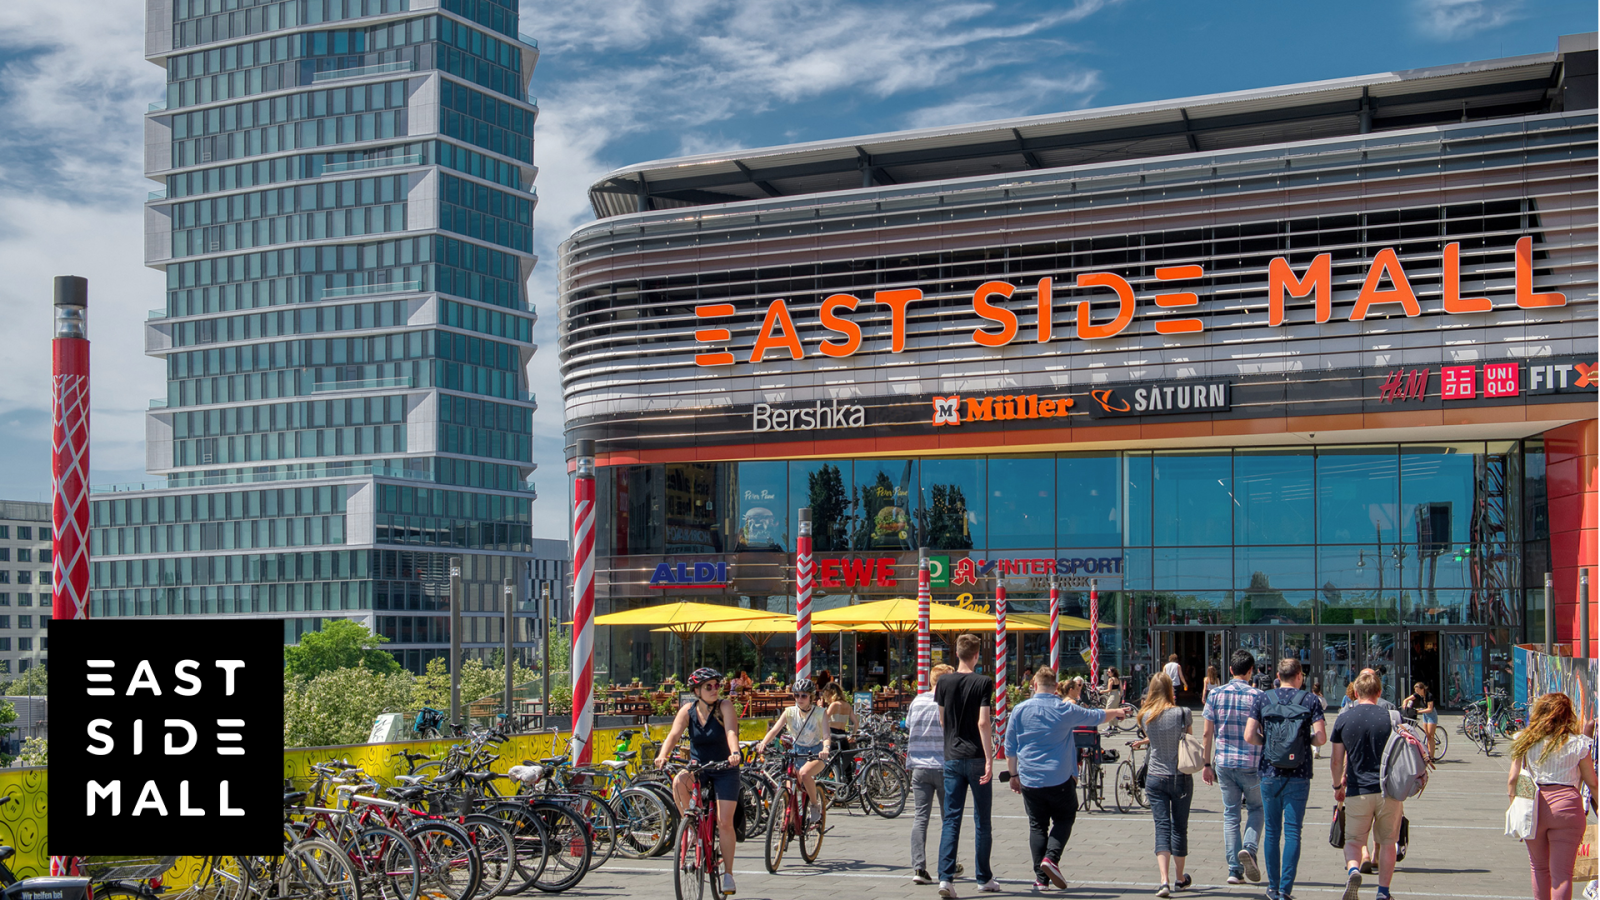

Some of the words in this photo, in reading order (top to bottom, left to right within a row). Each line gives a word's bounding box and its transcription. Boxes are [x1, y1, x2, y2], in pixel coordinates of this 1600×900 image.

[694, 287, 923, 367] EAST
[972, 264, 1204, 348] SIDE
[1268, 235, 1567, 328] MALL
[1378, 368, 1430, 403] H&M
[1487, 367, 1513, 381] UNI
[1134, 384, 1225, 412] SATURN
[1487, 380, 1515, 395] QLO
[752, 399, 866, 433] Bershka
[965, 394, 1075, 422] Müller
[650, 562, 727, 583] ALDI
[998, 557, 1124, 576] INTERSPORT
[22, 891, 33, 900] Wir
[34, 891, 52, 899] helfen
[53, 890, 63, 899] bei
